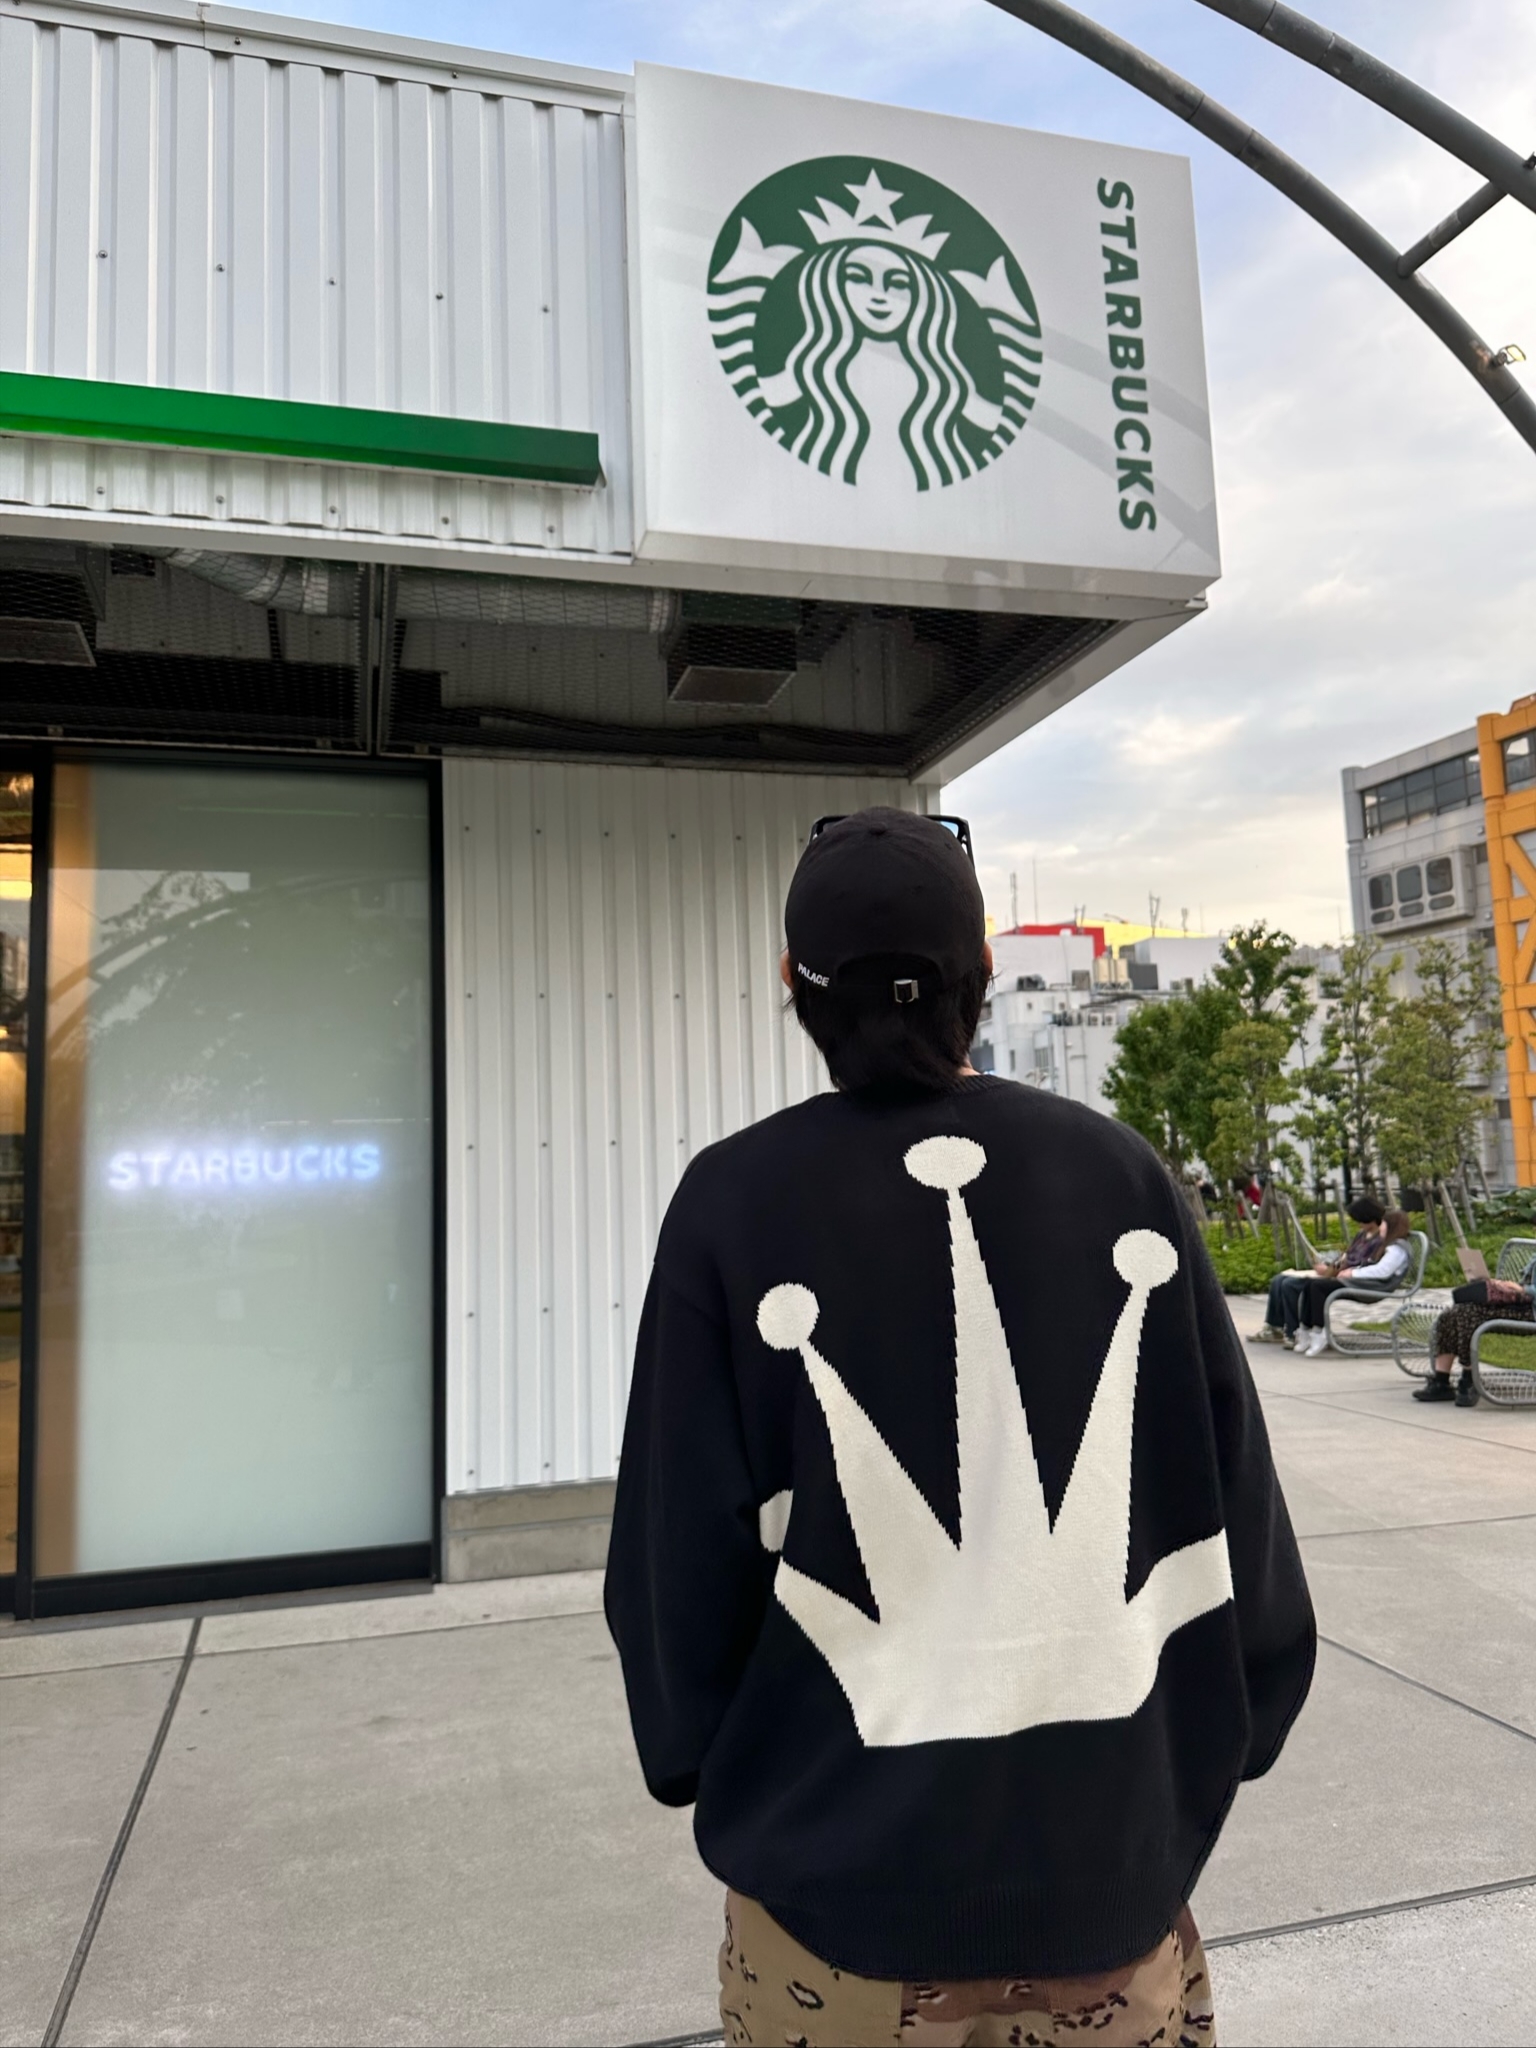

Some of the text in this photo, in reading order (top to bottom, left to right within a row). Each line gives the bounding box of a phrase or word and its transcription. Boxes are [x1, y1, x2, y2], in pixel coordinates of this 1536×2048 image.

[1097, 177, 1157, 532] STARBUCKS
[797, 962, 830, 987] PALACE
[108, 1144, 381, 1191] STARBUCKS
